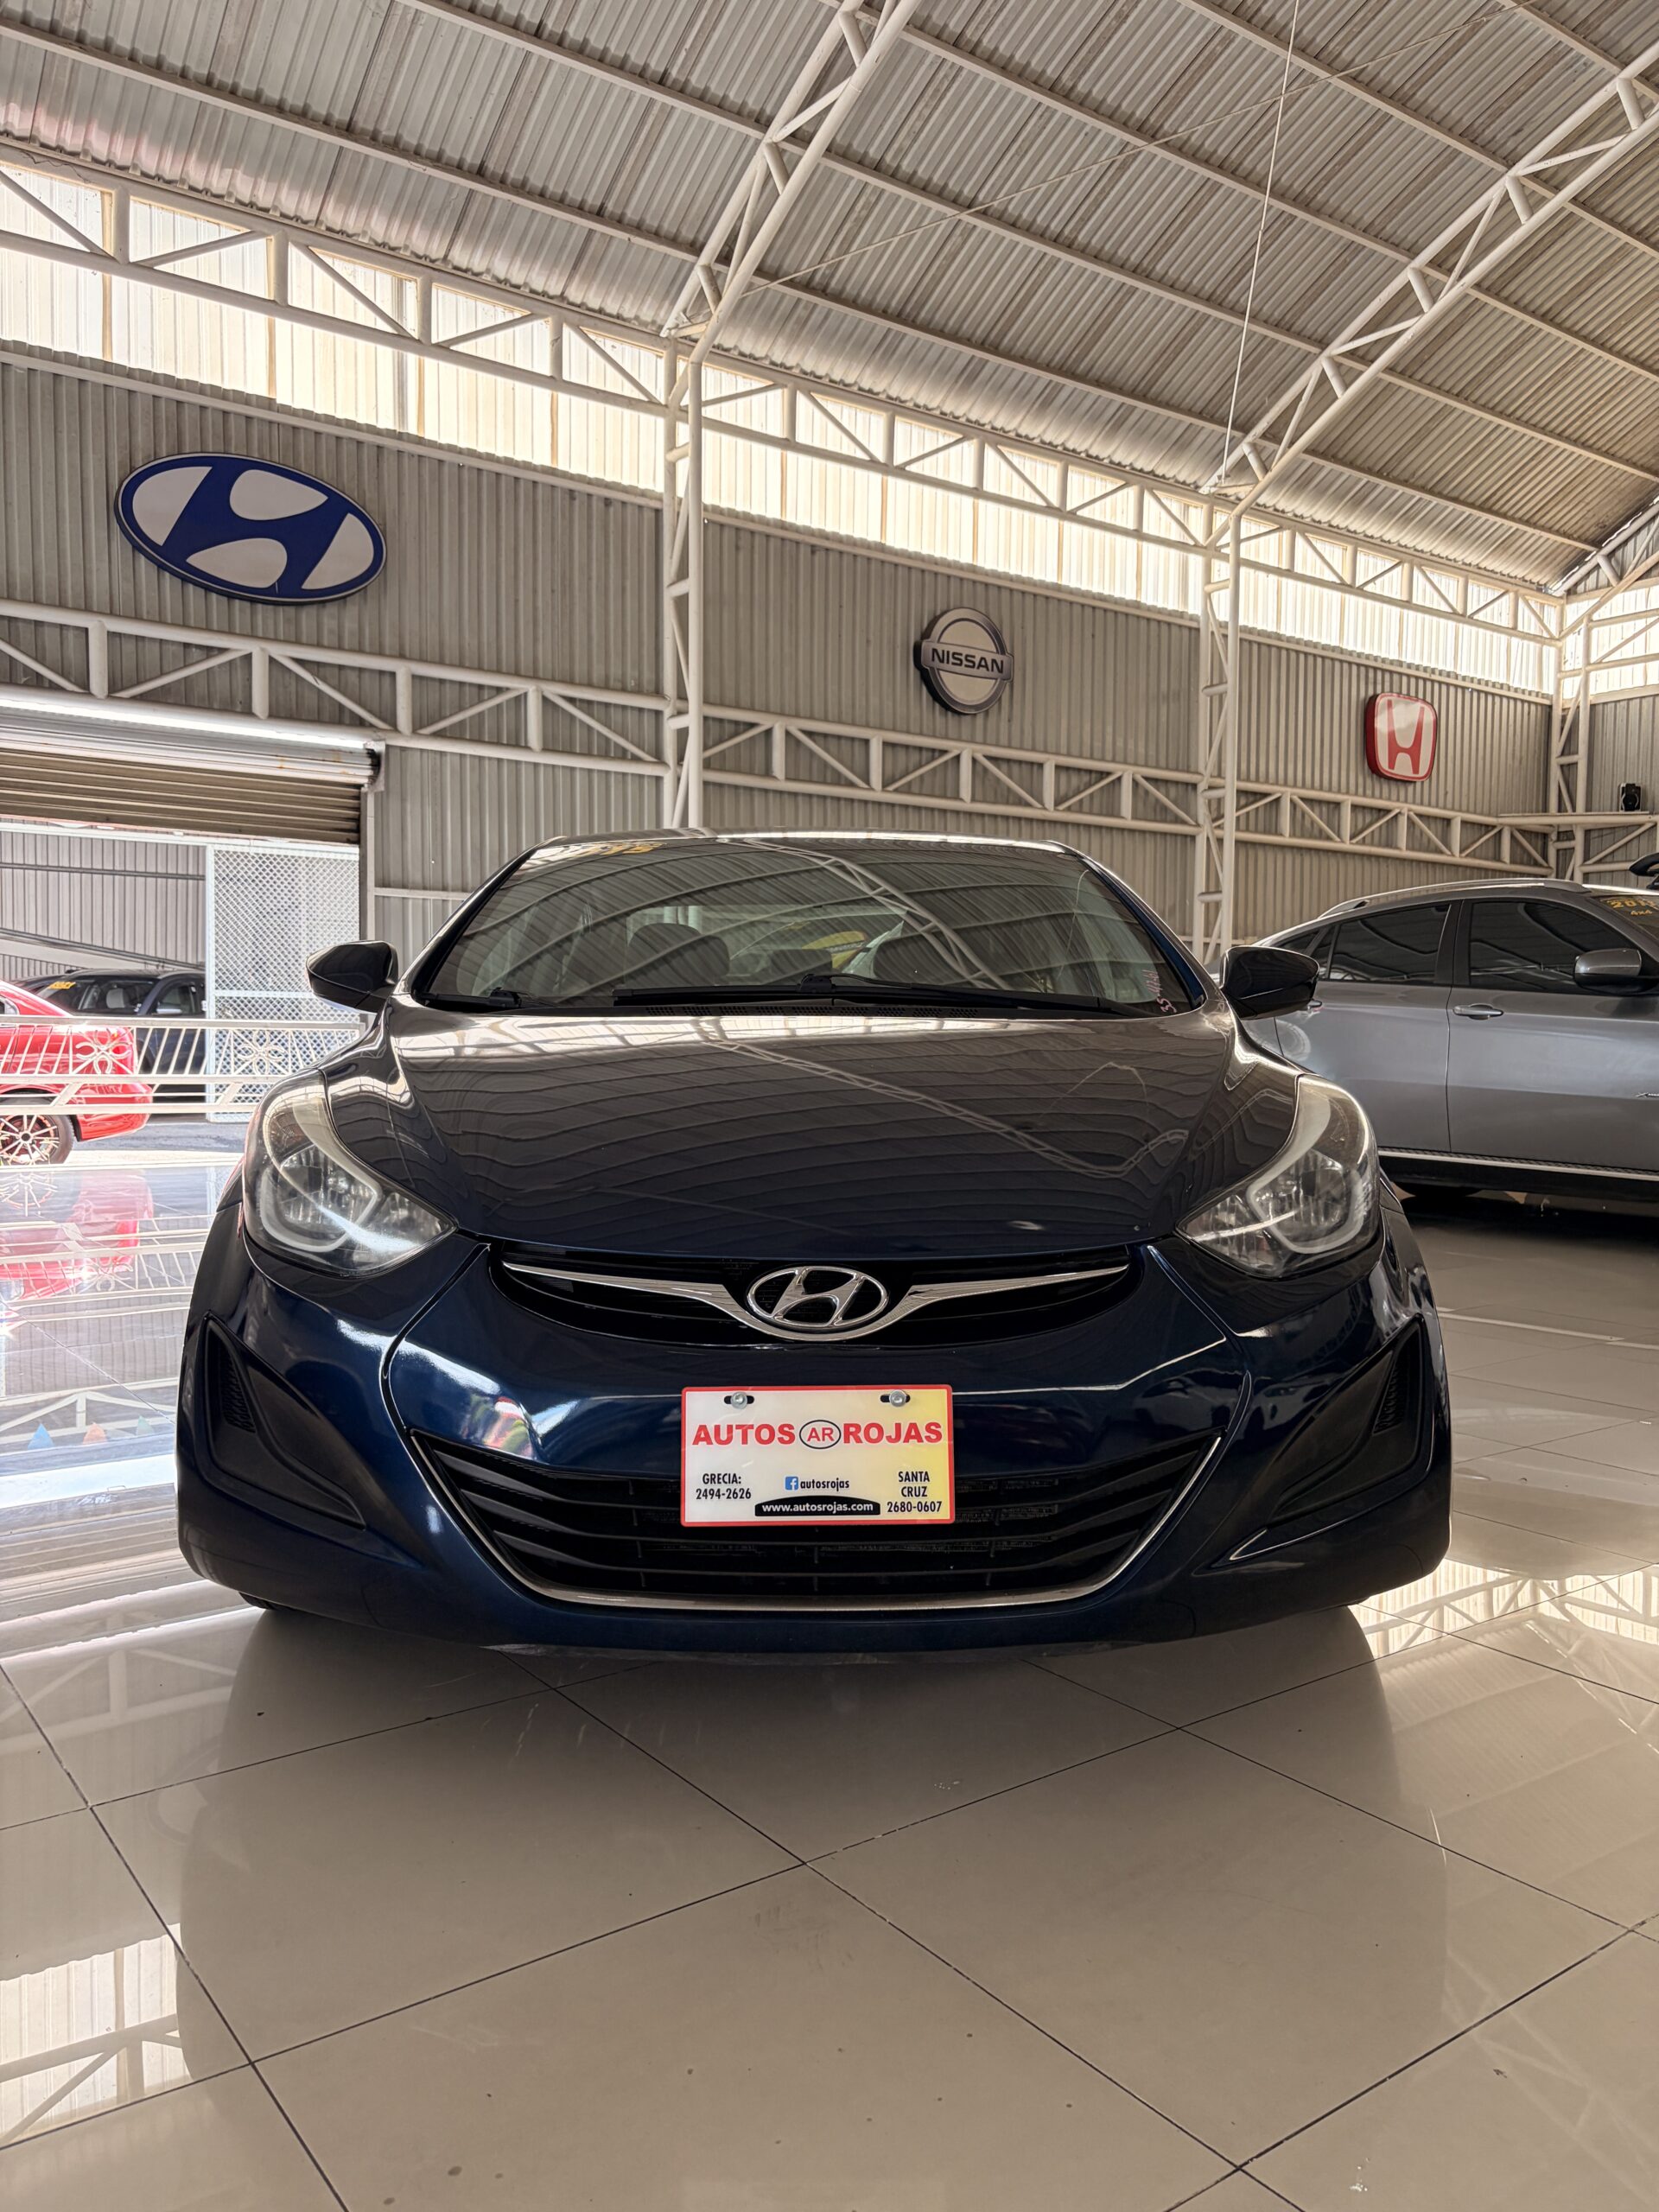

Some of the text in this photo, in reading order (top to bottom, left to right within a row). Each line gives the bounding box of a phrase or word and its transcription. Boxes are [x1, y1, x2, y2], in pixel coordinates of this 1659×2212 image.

[931, 648, 1004, 674] NISSAN
[692, 1421, 943, 1446] AUTOS AR ROJAS
[702, 1473, 741, 1484] GRECIA:
[899, 1471, 930, 1483] SANTA
[800, 1478, 849, 1492] autosrojas
[696, 1488, 752, 1500] 2494-2626
[901, 1486, 928, 1497] CRUZ
[762, 1502, 874, 1515] www.autosrojas.com
[887, 1501, 943, 1513] 2680-0607
